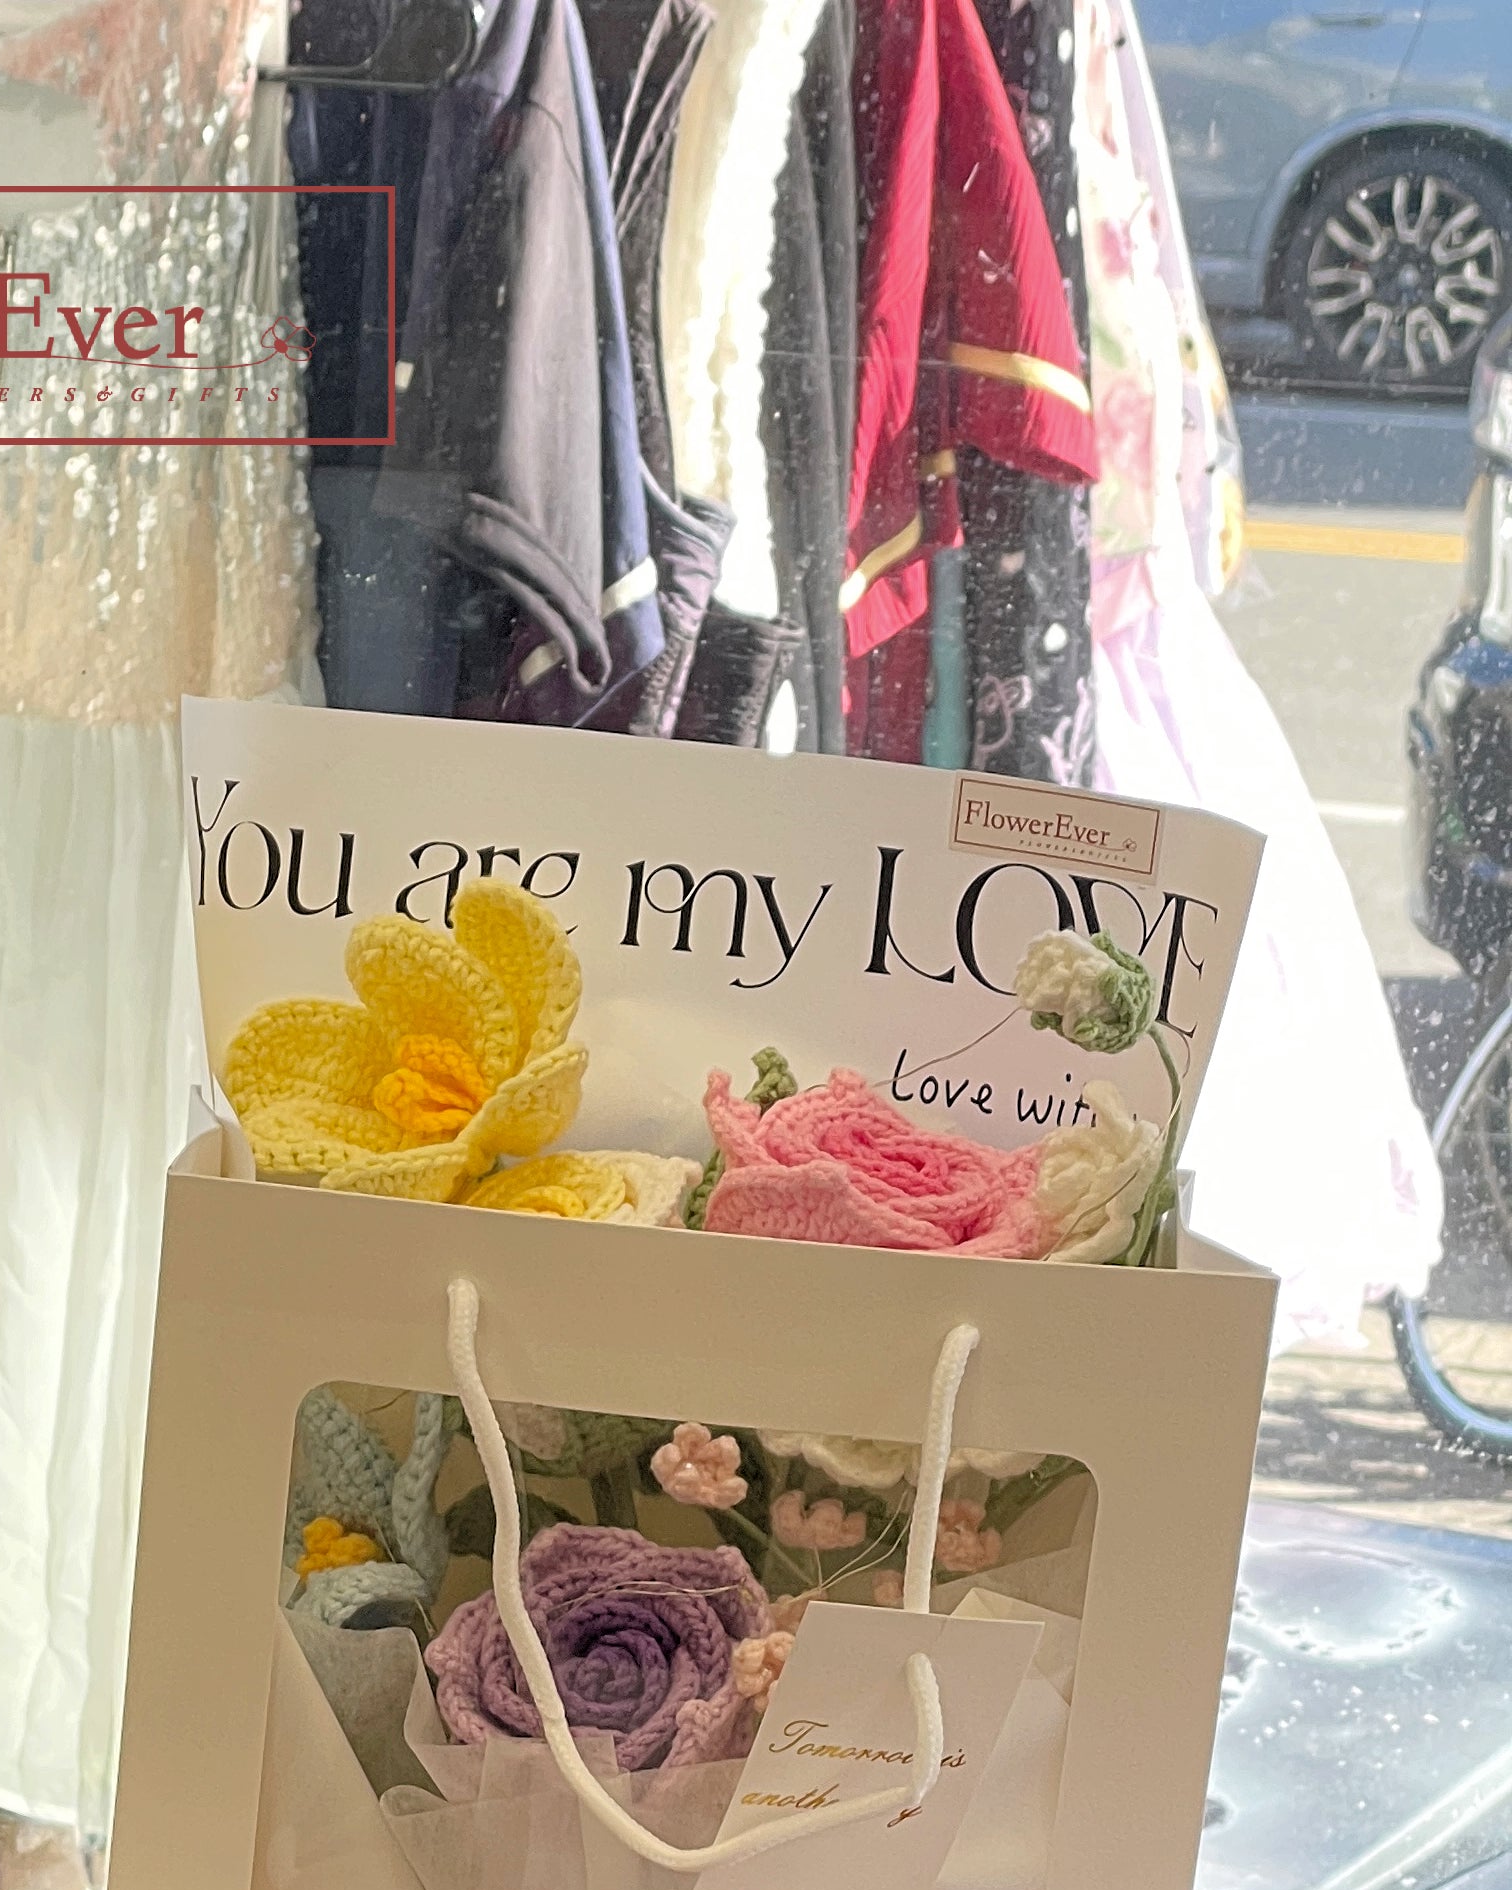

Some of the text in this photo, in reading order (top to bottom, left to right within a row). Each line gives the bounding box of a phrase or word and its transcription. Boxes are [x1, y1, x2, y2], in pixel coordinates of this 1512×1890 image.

[964, 799, 1111, 847] FlowerEver
[190, 775, 356, 919] You
[620, 857, 832, 988] my
[891, 1048, 1097, 1128] Love wit
